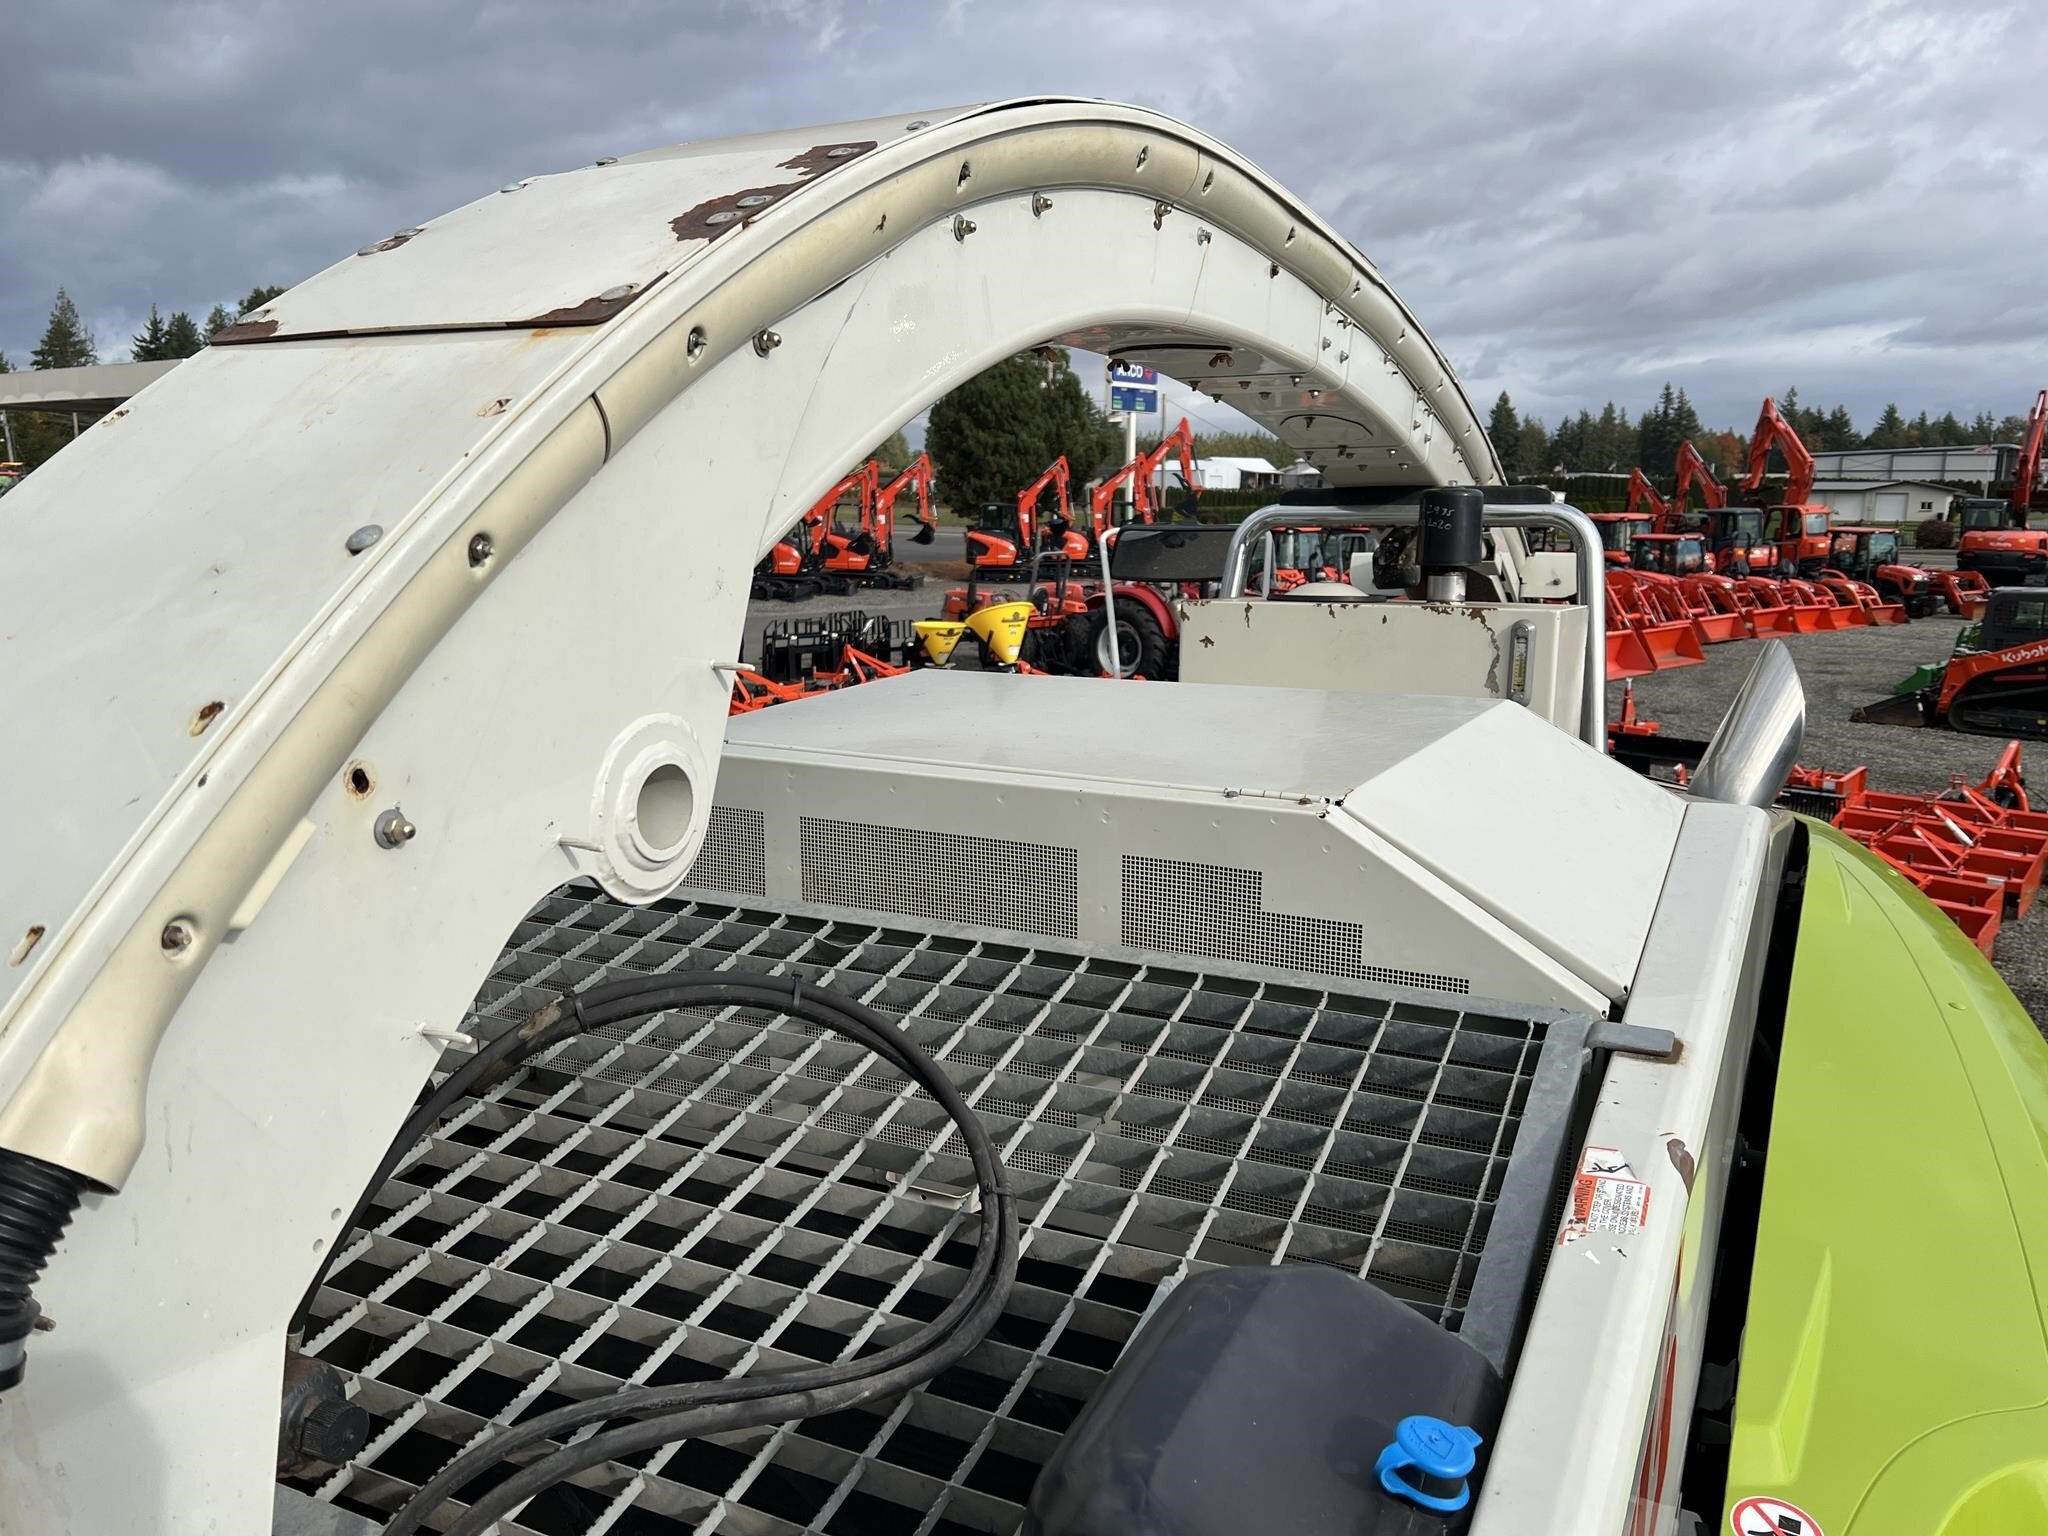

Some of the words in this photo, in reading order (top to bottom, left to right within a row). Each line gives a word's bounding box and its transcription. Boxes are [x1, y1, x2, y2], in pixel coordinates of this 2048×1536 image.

[1573, 1180, 1592, 1217] WARNING
[1592, 1201, 1601, 1212] STEP
[1589, 1213, 1598, 1222] NOT
